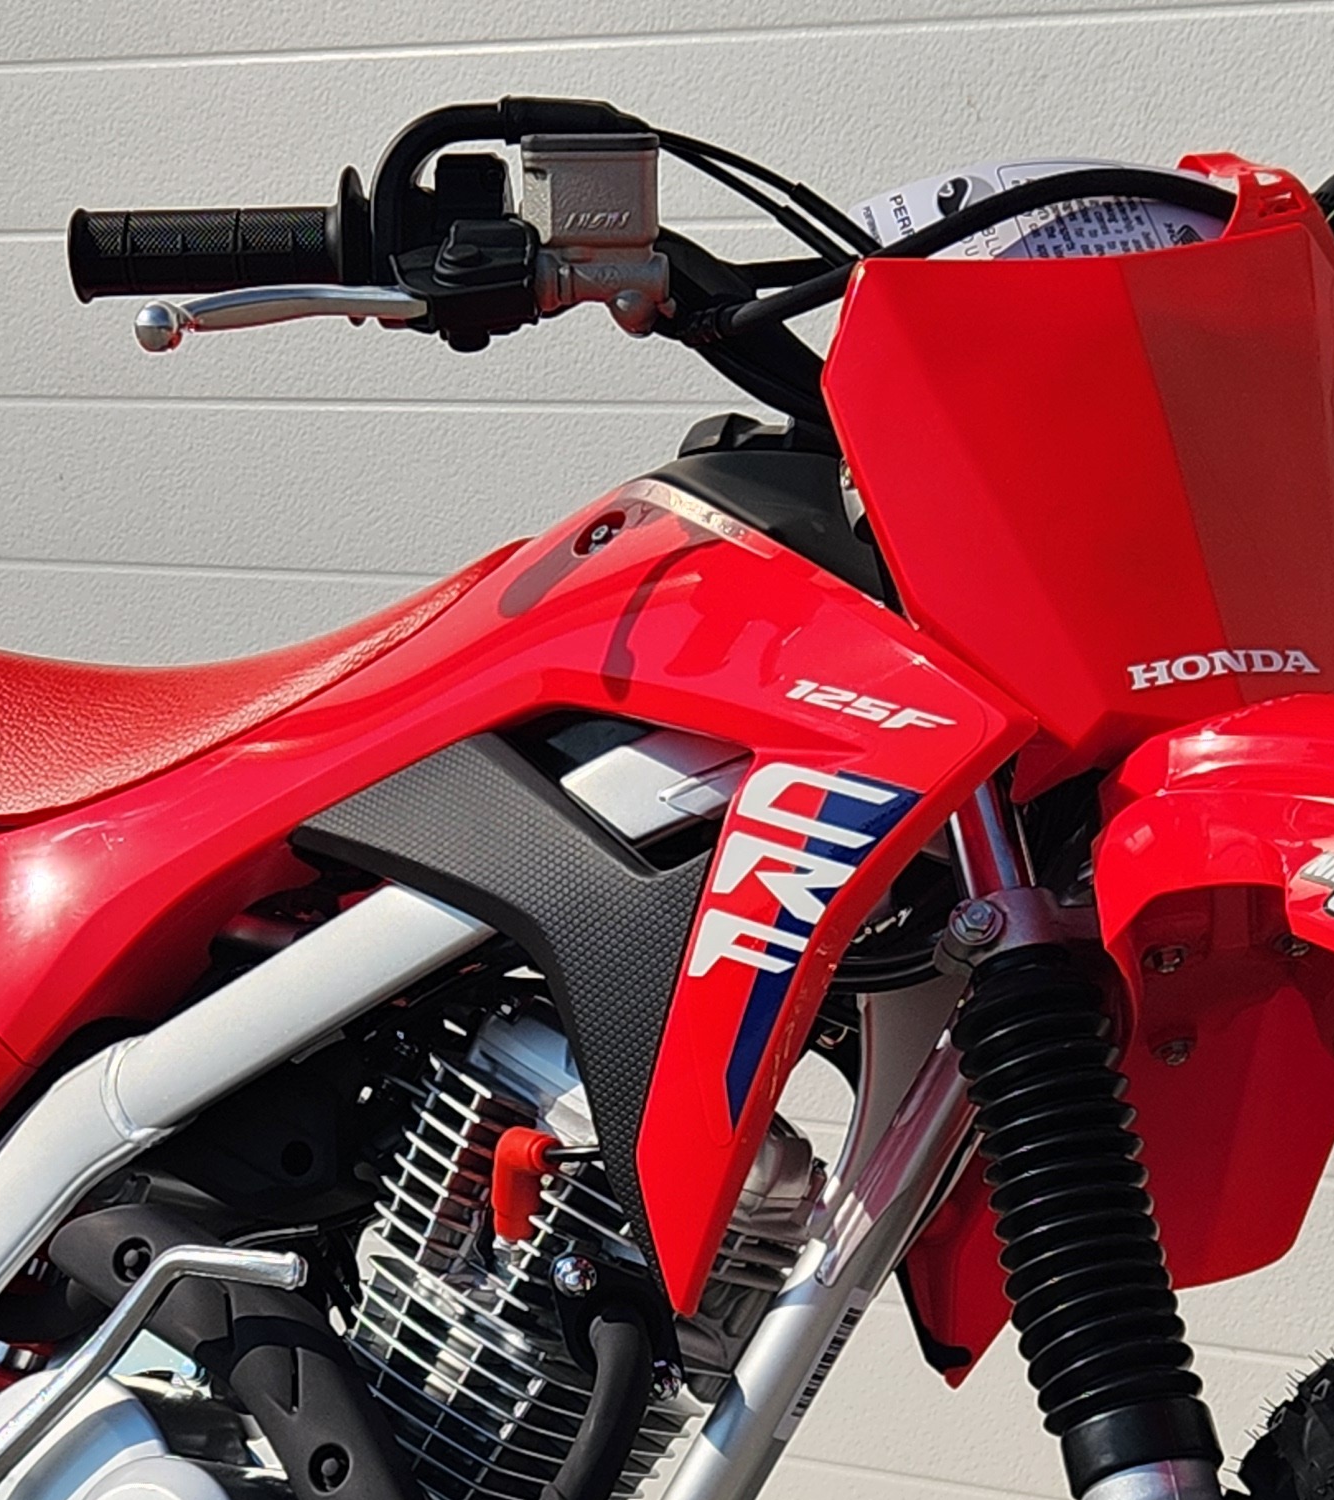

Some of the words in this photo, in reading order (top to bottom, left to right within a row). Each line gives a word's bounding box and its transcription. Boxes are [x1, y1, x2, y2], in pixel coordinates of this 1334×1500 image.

[1126, 650, 1321, 690] HONDA
[784, 678, 958, 729] 125F
[687, 762, 900, 977] CRF
